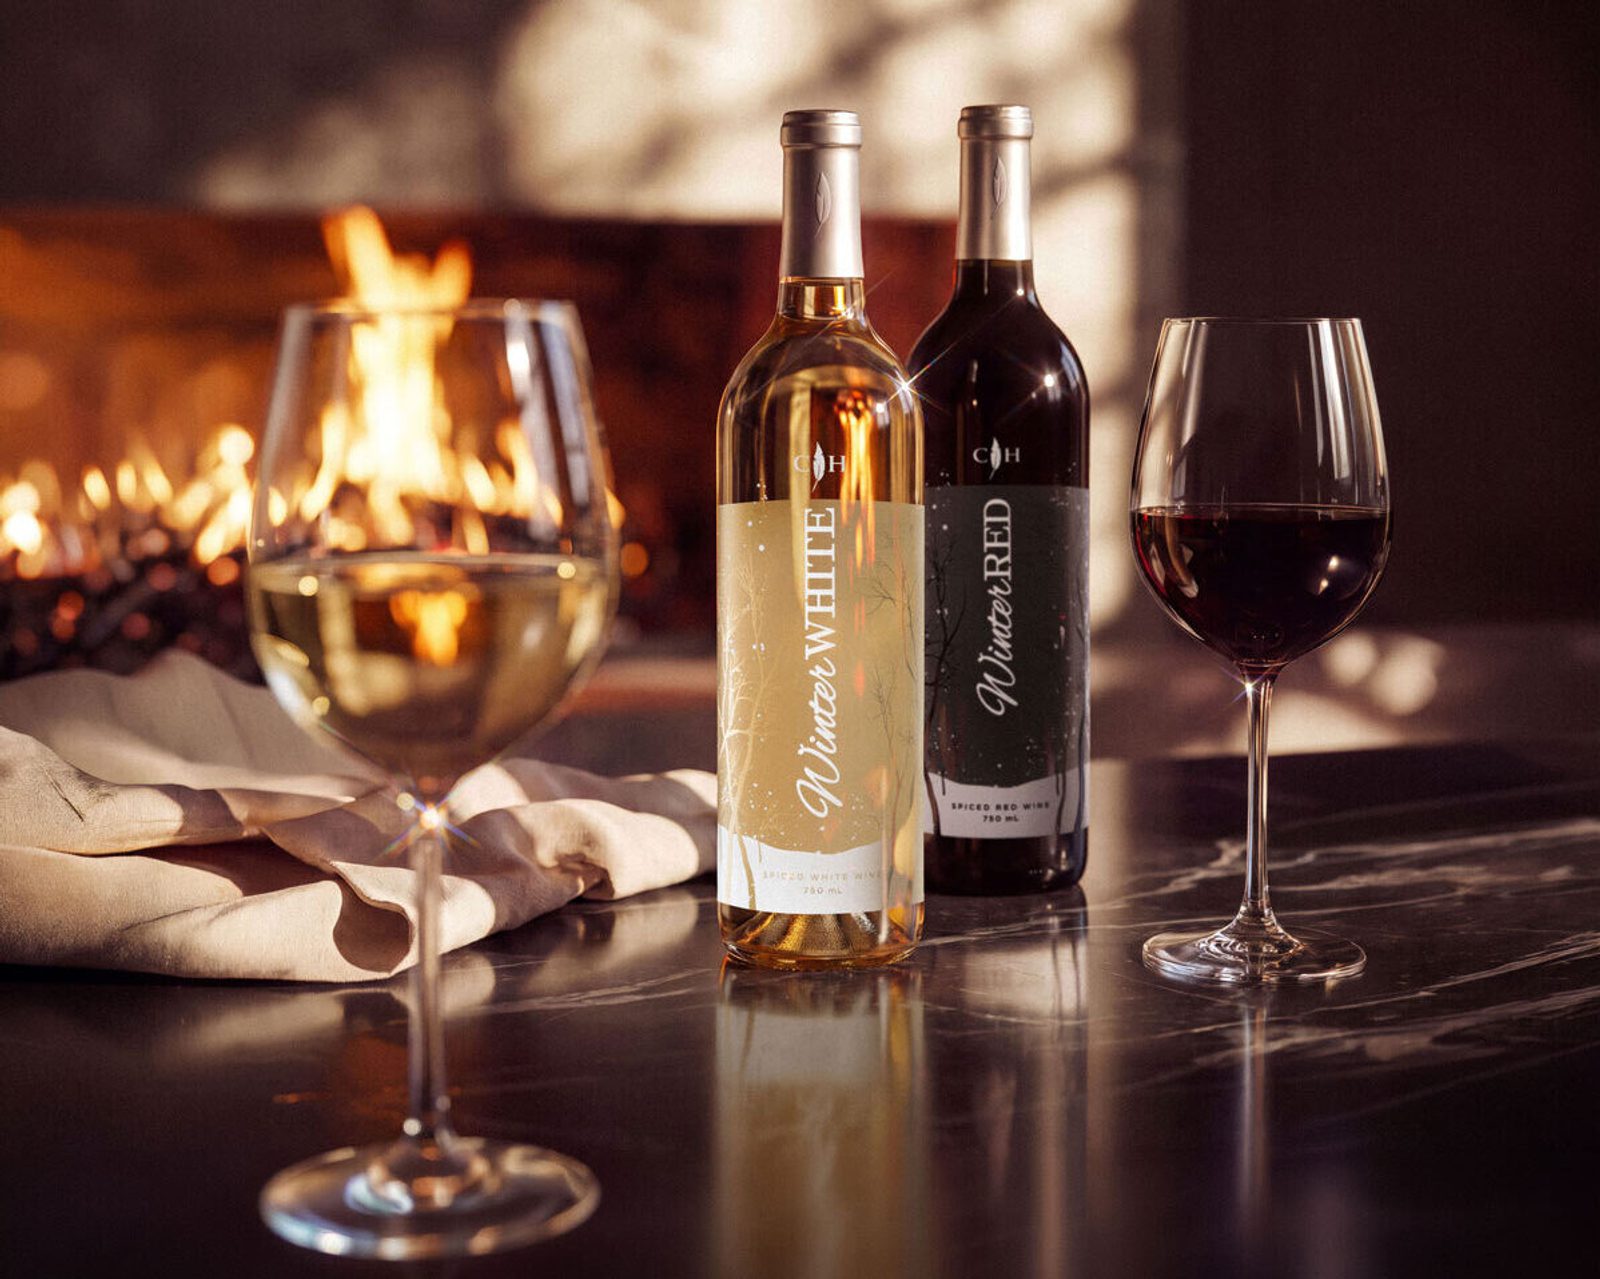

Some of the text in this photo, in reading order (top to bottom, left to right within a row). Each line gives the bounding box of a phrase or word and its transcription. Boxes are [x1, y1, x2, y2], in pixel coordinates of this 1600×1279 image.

[796, 507, 843, 818] Winter WHITE
[976, 498, 1019, 716] Winter RED
[951, 803, 990, 811] SPICED
[810, 873, 848, 881] WHITE
